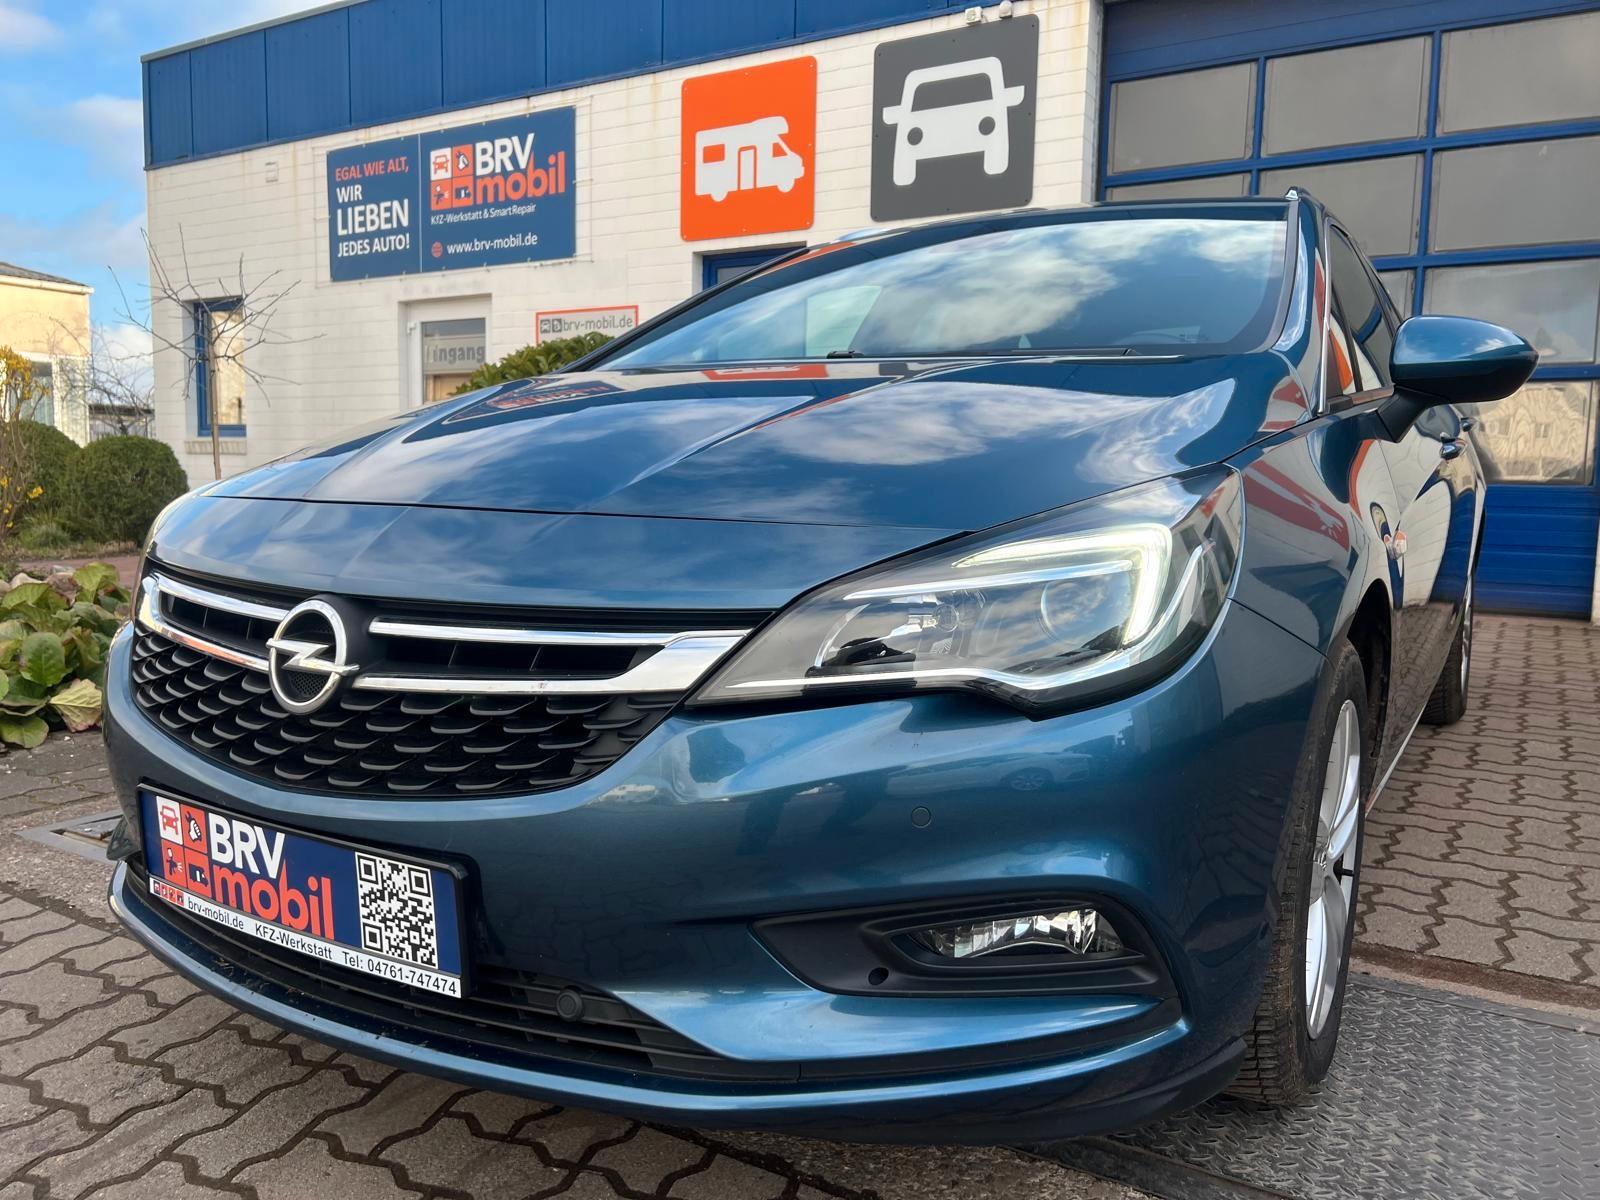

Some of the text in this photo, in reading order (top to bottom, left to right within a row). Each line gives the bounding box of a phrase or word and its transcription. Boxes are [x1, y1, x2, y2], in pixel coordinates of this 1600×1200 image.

[336, 156, 409, 181] EGAL WIE ALT,
[475, 133, 534, 176] BRV
[336, 184, 363, 203] WIR
[476, 151, 566, 204] mobil
[337, 198, 409, 236] LIEBEN
[483, 208, 489, 219] &
[338, 232, 410, 258] JEDES AUTO!
[447, 232, 538, 254] www.brv-mobil.de
[563, 315, 633, 332] brv-mobil.de
[208, 812, 285, 879] BRV
[212, 859, 335, 941] mobil
[188, 897, 457, 995] brv-mobil.de KFZ-Werkstatt Tel: 04761-747474
